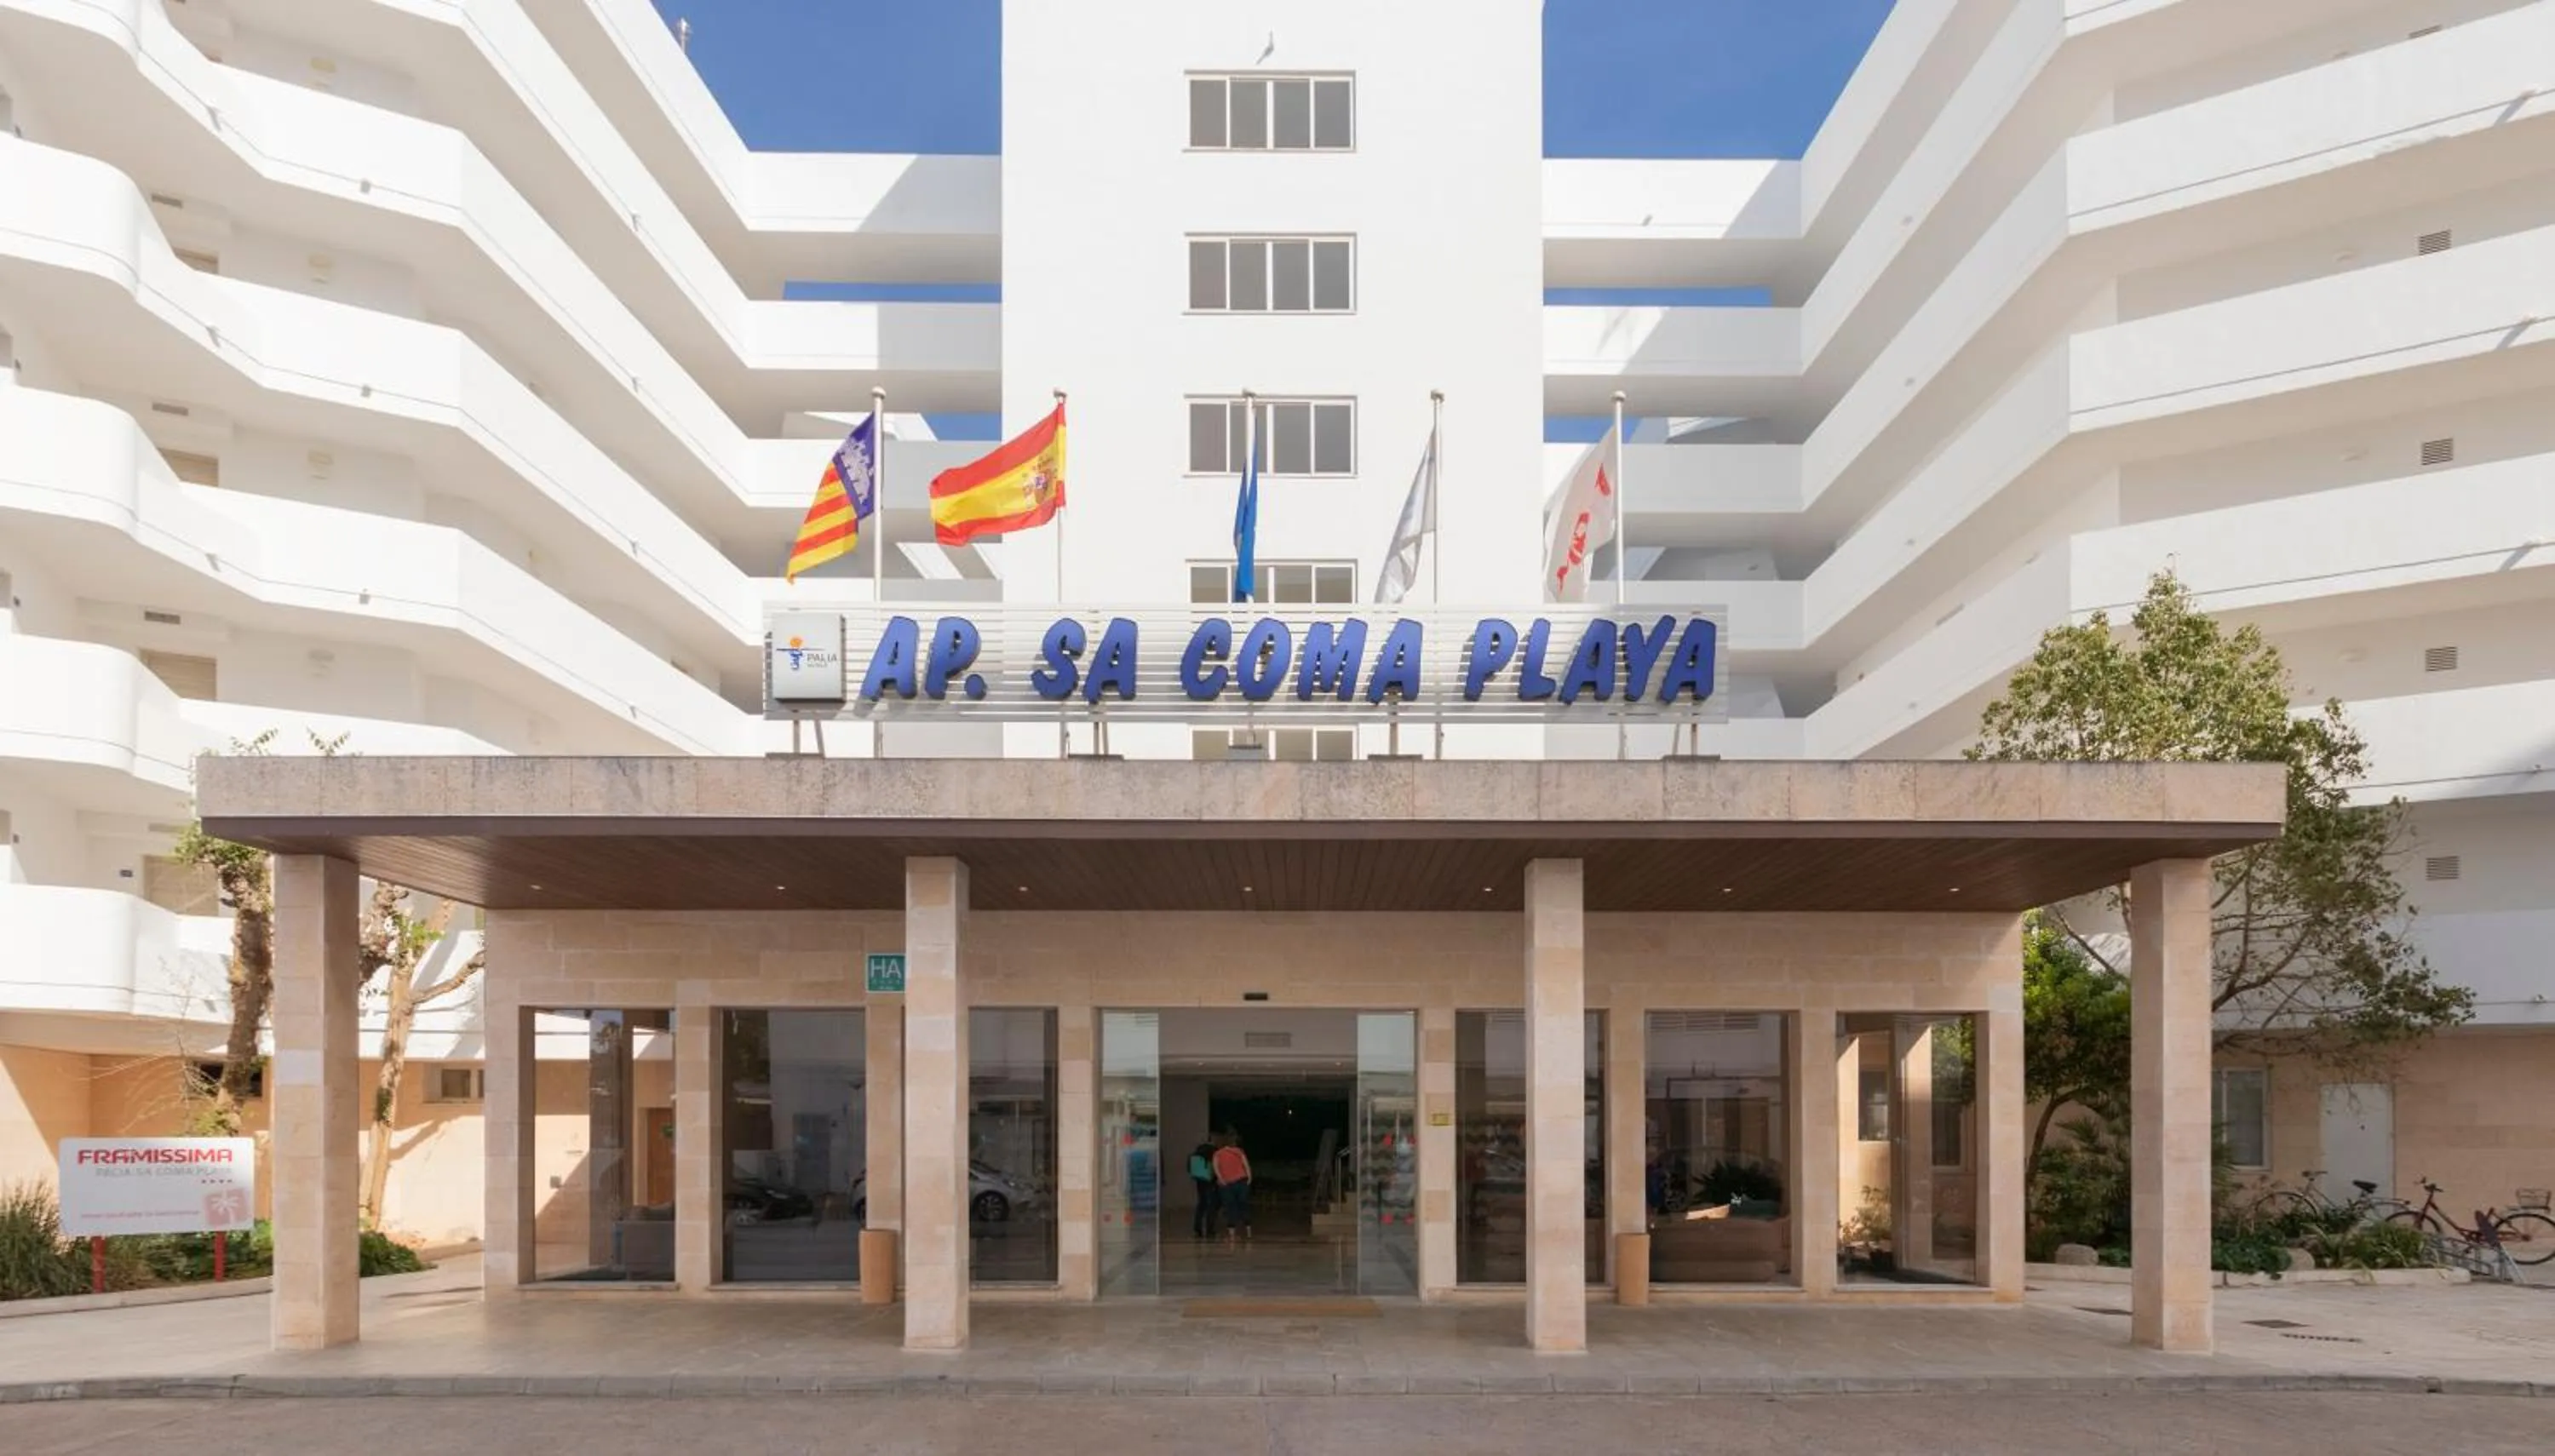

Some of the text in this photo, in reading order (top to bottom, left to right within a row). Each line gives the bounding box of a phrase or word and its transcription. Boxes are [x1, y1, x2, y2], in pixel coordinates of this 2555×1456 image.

[859, 615, 1717, 705] AP. SA COMA PLAYA
[870, 958, 902, 979] HA
[78, 1149, 233, 1164] FRAMISSIMA
